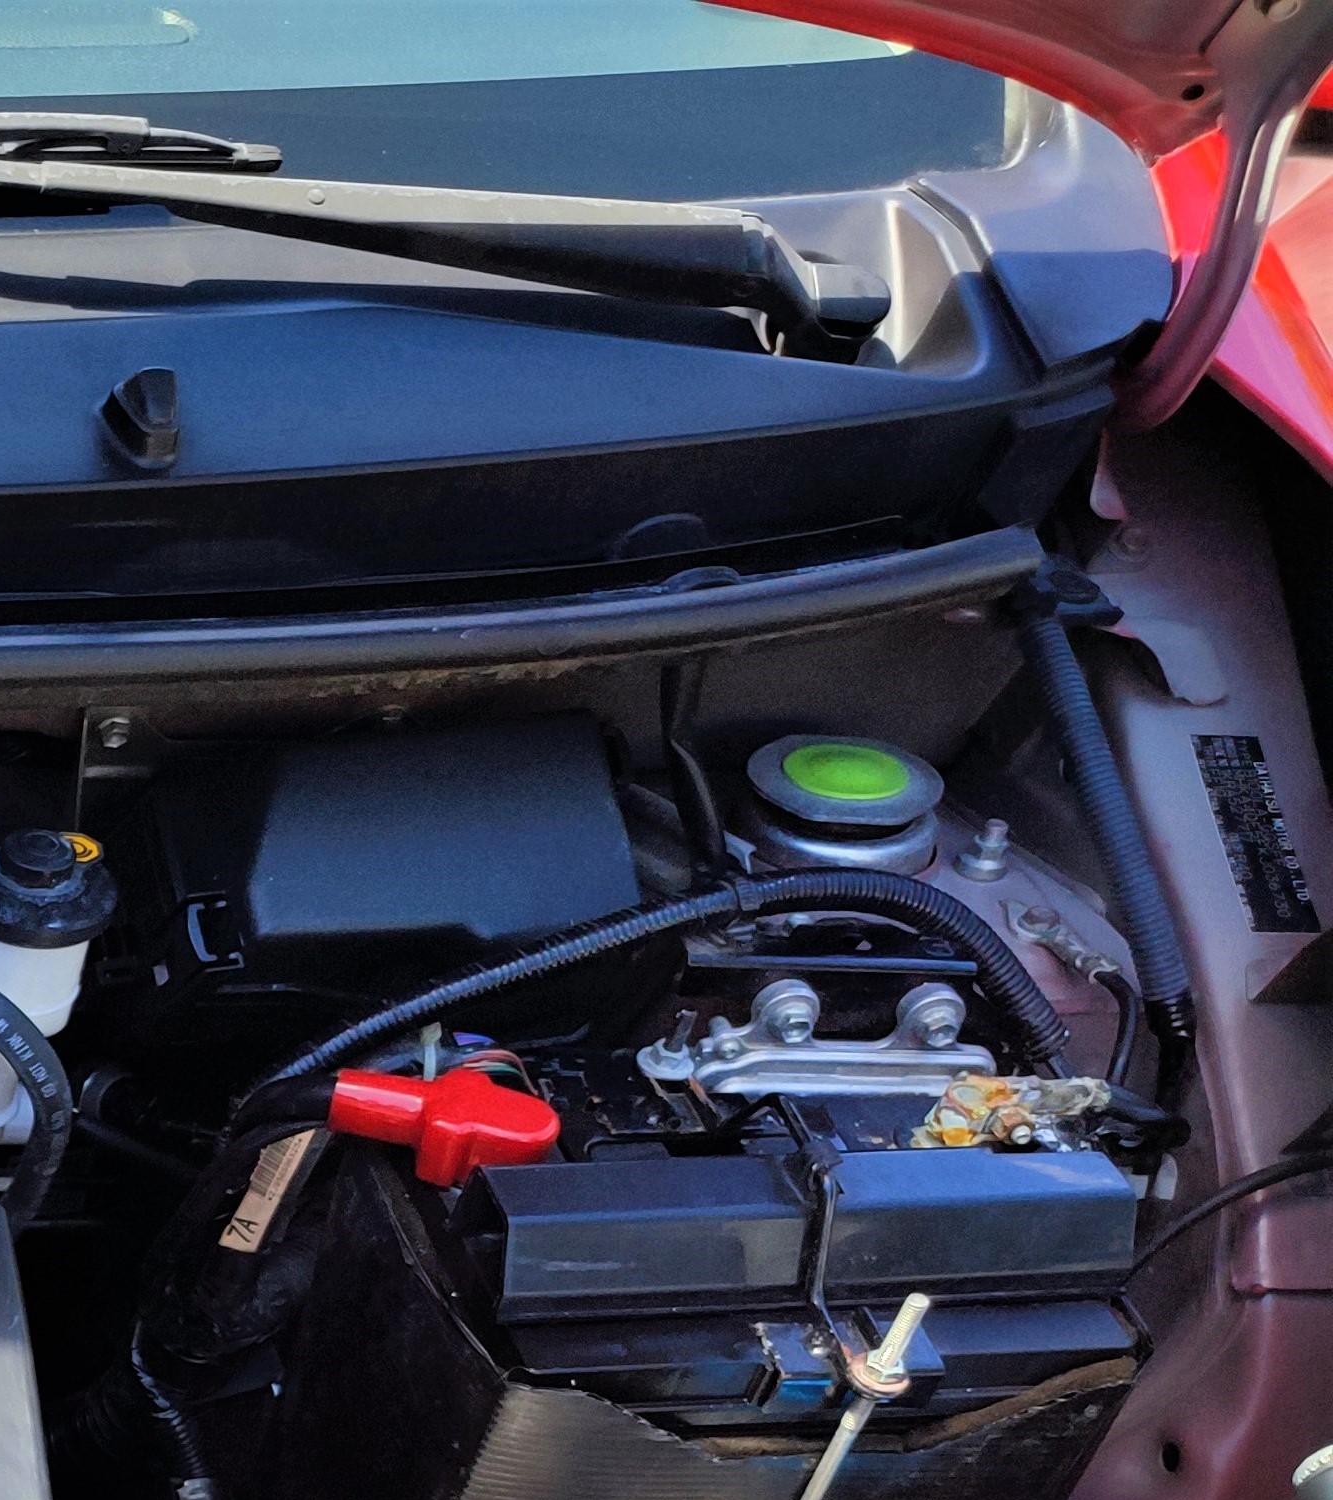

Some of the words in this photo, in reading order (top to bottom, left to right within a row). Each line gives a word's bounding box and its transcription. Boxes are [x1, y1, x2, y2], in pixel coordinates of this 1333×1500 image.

[1252, 761, 1281, 812] DAIHATSU
[1271, 818, 1293, 849] MOTOR
[6, 1032, 34, 1062] KINK
[29, 1062, 50, 1084] NOT
[226, 1217, 258, 1243] 7A
